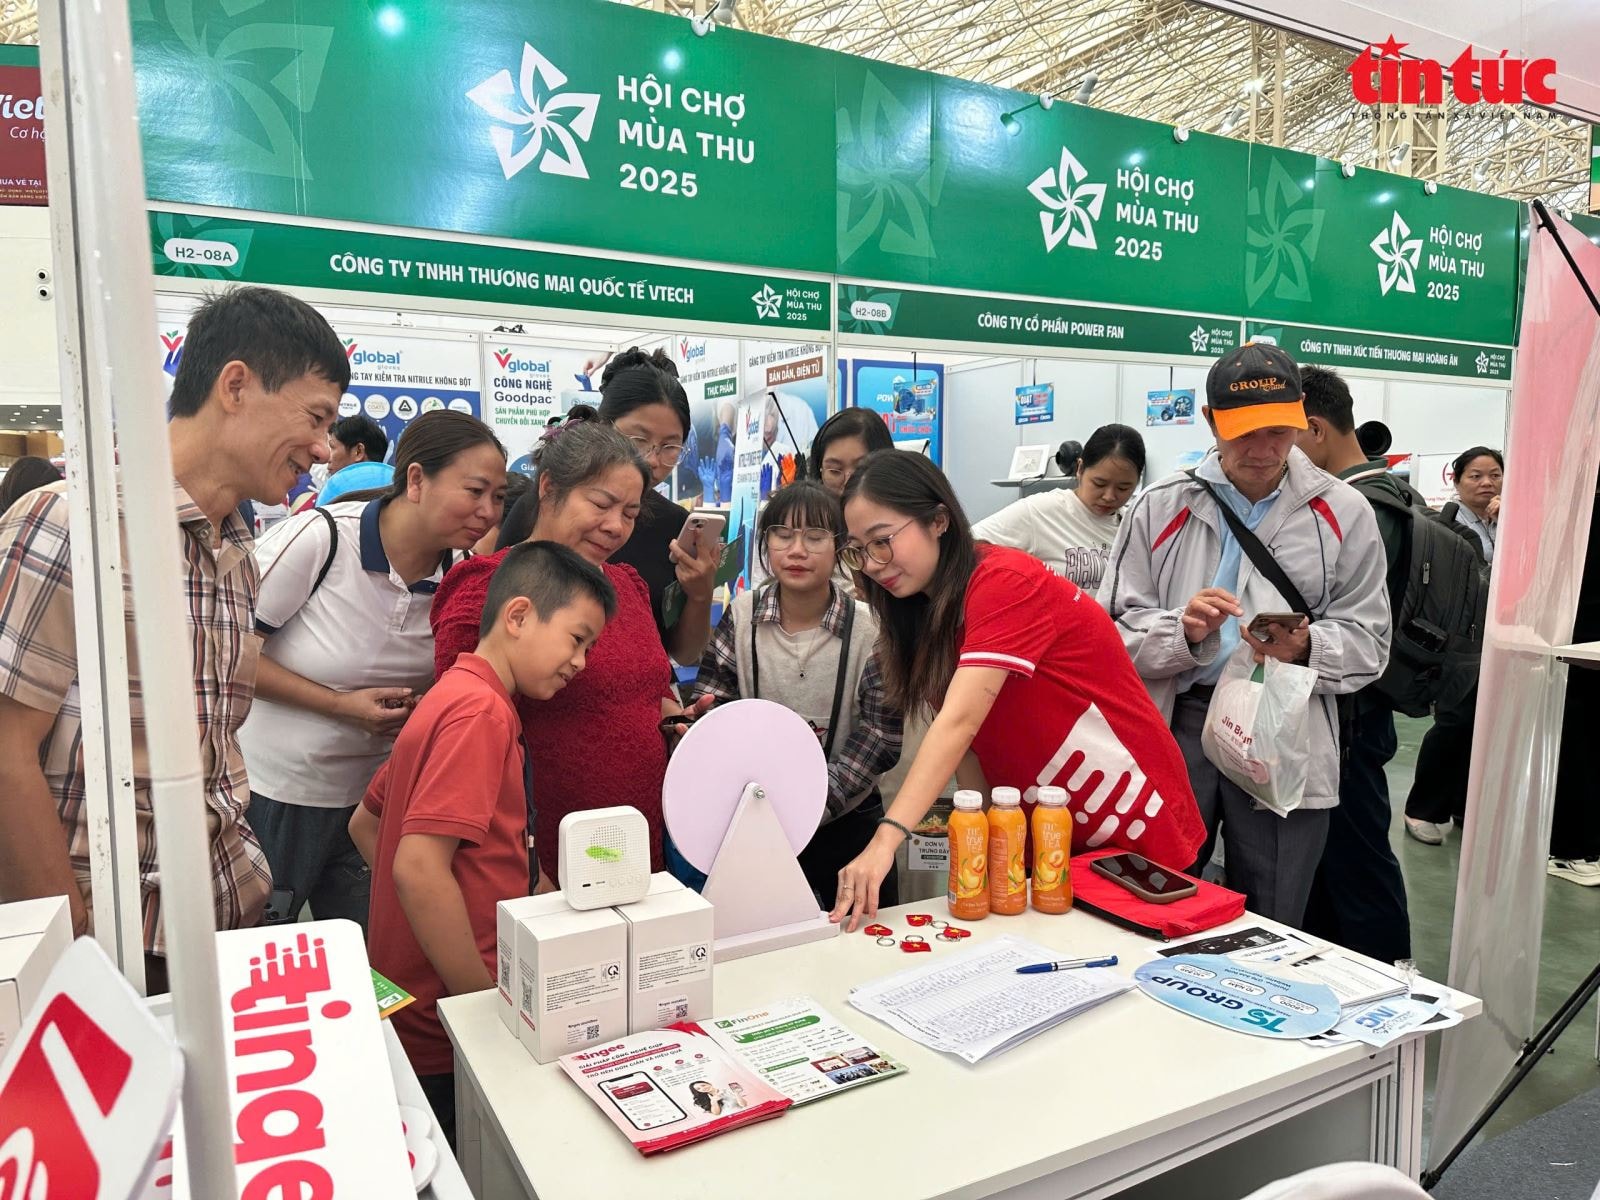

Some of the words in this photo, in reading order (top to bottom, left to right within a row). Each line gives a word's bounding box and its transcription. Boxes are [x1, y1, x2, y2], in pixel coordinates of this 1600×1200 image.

[617, 73, 672, 113] HỘI
[680, 88, 746, 128] CHỢ
[618, 116, 688, 155] MÙA
[696, 131, 755, 164] THU
[619, 163, 698, 198] 2025
[1116, 166, 1149, 196] HỘI
[1154, 176, 1195, 206] CHỢ
[1116, 199, 1158, 228] MÙA
[1162, 210, 1199, 234] THU
[1115, 236, 1163, 261] 2025
[1429, 223, 1452, 250] HỘI
[1455, 231, 1483, 256] CHỢ
[175, 246, 234, 263] H2-08A
[1428, 252, 1457, 275] MÙA
[1460, 259, 1486, 279] THU
[330, 251, 383, 276] CÔNG
[388, 259, 410, 278] TY
[416, 261, 464, 283] TNHH
[468, 265, 539, 290] THƯƠNG
[544, 274, 575, 294] MẠI
[579, 275, 624, 298] QUỐC
[628, 279, 648, 300] TẾ
[648, 285, 694, 305] VTECH
[786, 287, 801, 299] HỘI
[802, 289, 820, 301] CHỢ
[1427, 281, 1460, 301] 2025
[786, 298, 805, 310] MÙA
[806, 302, 823, 311] THU
[855, 306, 887, 318] H2-08B
[786, 312, 808, 321] 2025
[978, 311, 1008, 330] CÔNG
[1009, 317, 1024, 331] TY
[1025, 313, 1039, 331] CỔ
[1041, 316, 1069, 335] PHẦN
[1070, 321, 1104, 337] POWER
[1106, 325, 1124, 340] FAN
[1301, 339, 1322, 353] CÔNG
[1322, 344, 1333, 353] TY
[1333, 344, 1352, 355] TNHH
[360, 372, 373, 381] TAY
[393, 375, 407, 383] TRA
[407, 376, 433, 384] NITRILE
[494, 375, 522, 389] CÔNG
[525, 378, 552, 393] NGHỆ
[1230, 377, 1278, 391] GROUP
[494, 391, 552, 406] Goodpac
[876, 393, 894, 402] POW
[1151, 974, 1244, 1011] GROUP
[731, 1011, 769, 1025] FinOne
